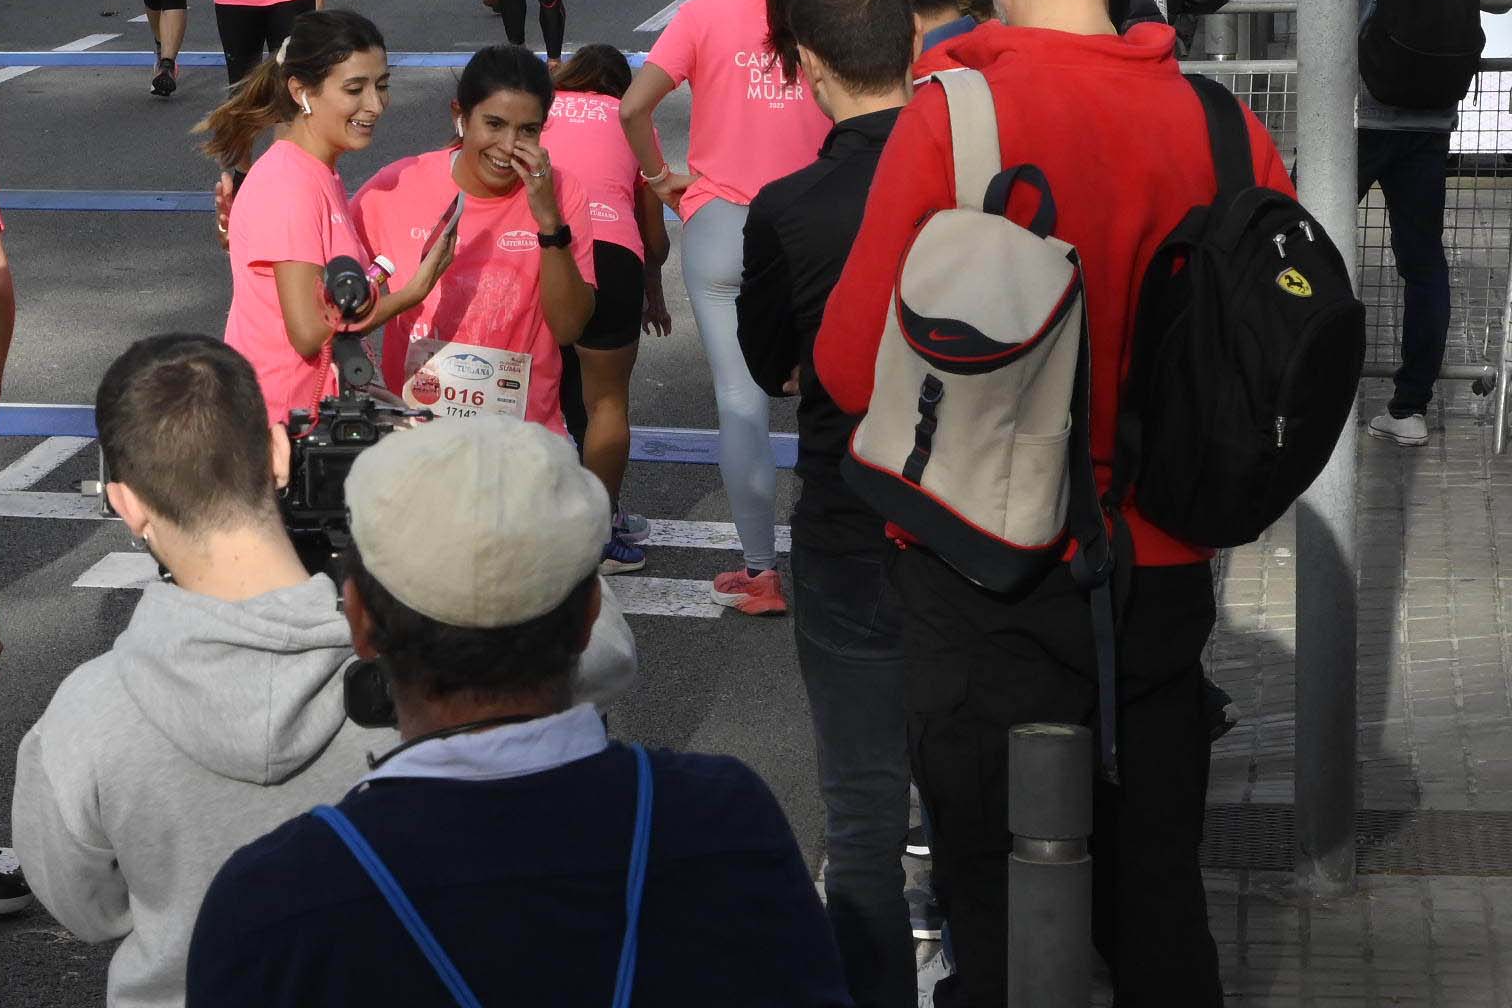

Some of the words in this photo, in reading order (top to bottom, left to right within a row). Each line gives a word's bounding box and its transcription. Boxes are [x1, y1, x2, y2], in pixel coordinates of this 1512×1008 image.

[750, 71, 772, 84] DE
[746, 85, 803, 101] MUJER
[553, 102, 571, 111] DE
[584, 104, 605, 113] LA
[548, 109, 608, 122] MUJER
[444, 386, 484, 406] 016
